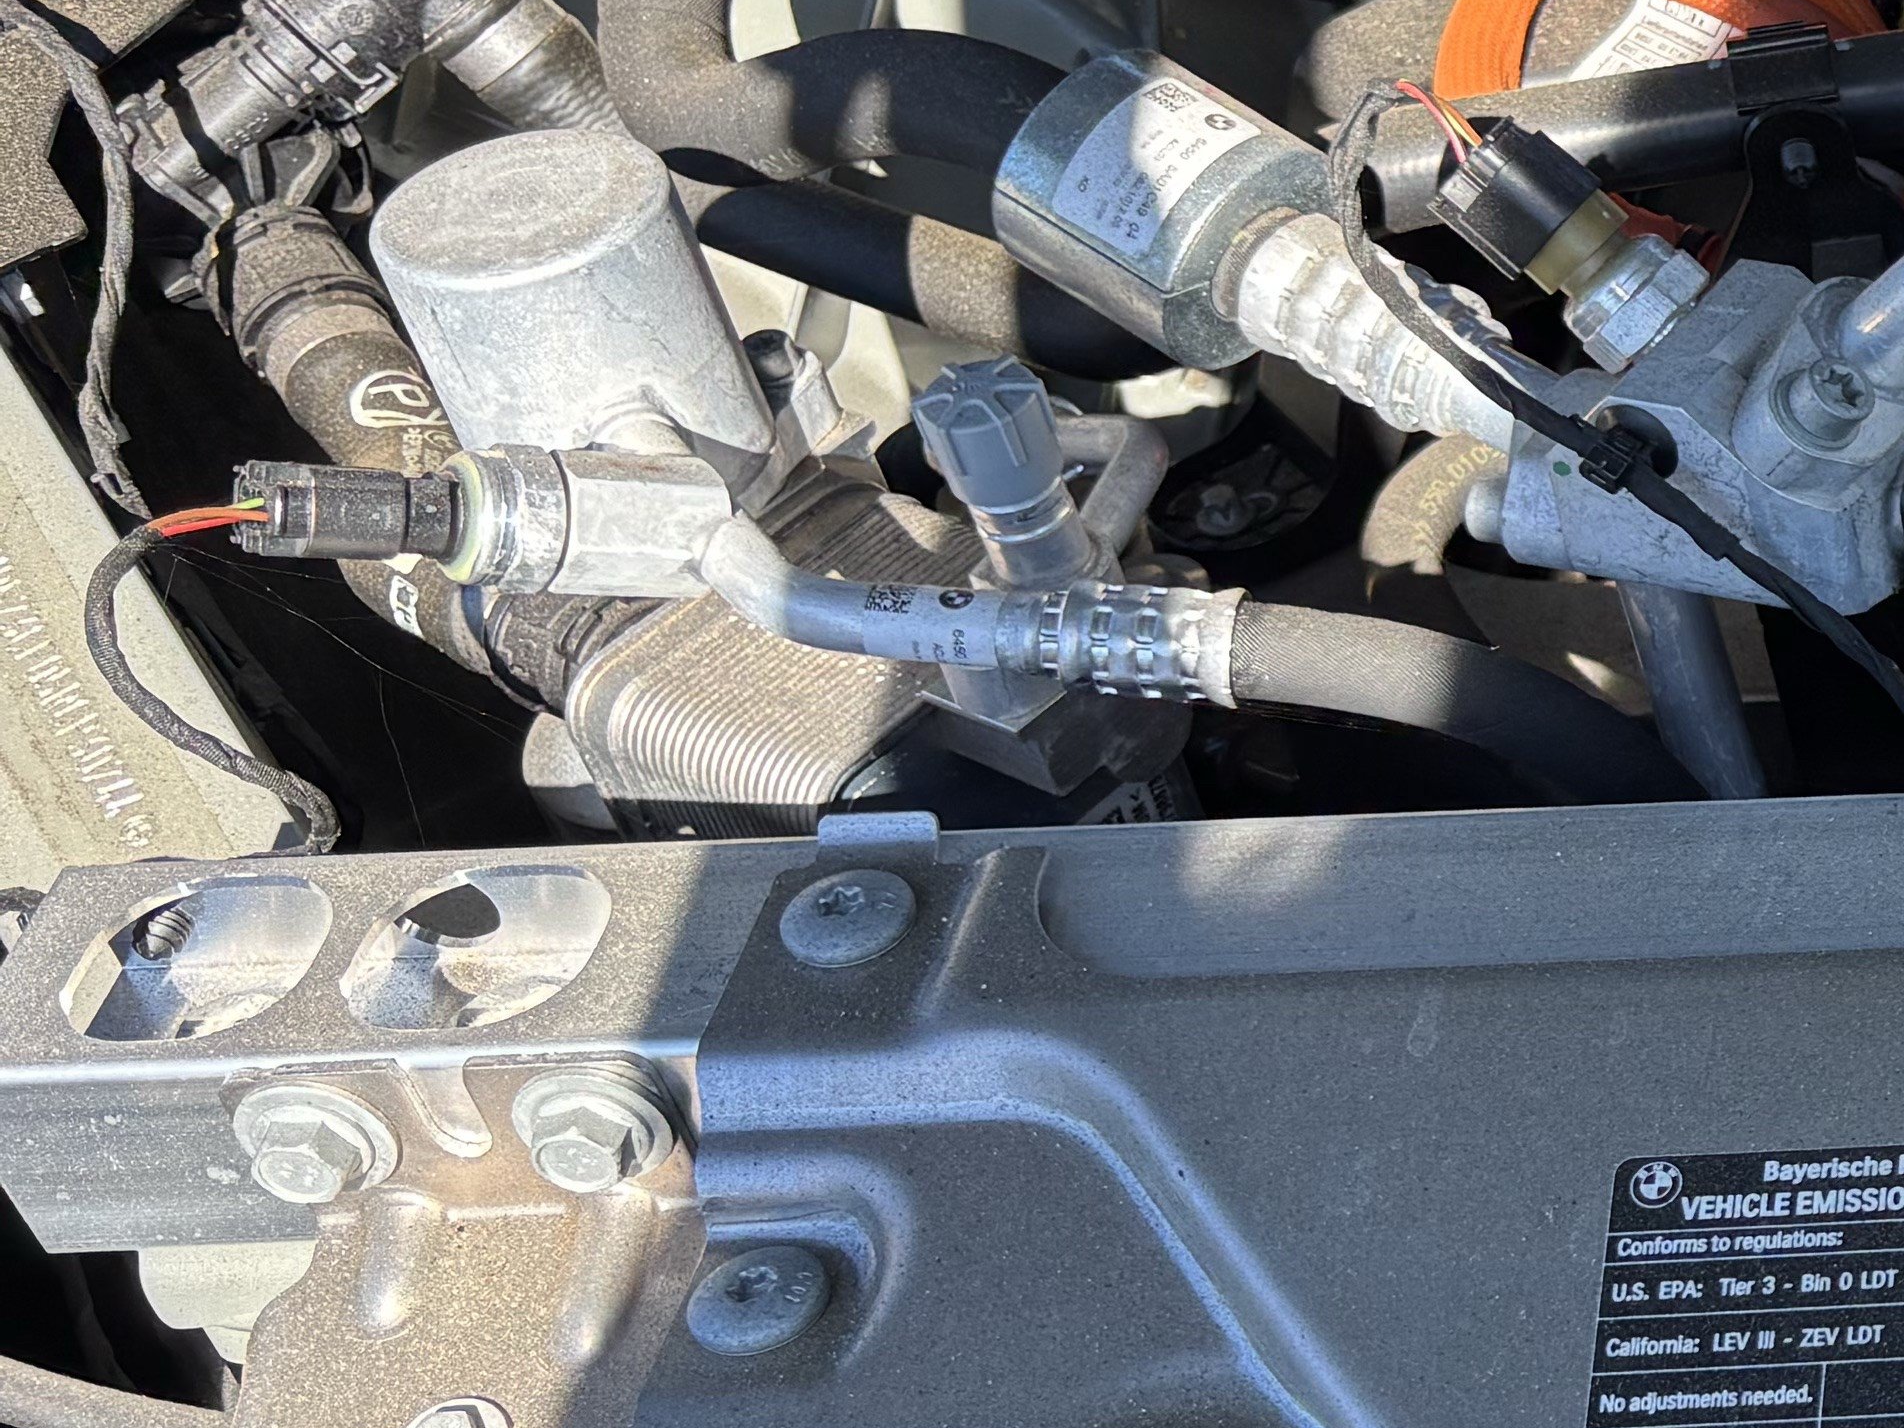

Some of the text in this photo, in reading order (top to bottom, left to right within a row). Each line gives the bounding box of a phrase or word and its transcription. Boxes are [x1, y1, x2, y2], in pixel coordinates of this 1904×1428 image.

[1764, 1156, 1892, 1185] Bayerische
[1681, 1193, 1791, 1221] VEHICLE
[1617, 1229, 1844, 1257] Conforms to regulations:
[1611, 1281, 1650, 1302] U.S.
[1658, 1279, 1703, 1300] EPA:
[1719, 1275, 1756, 1296] Tier
[1761, 1275, 1776, 1294] 3
[1801, 1272, 1832, 1292] Bin
[1839, 1271, 1854, 1291] 0
[1861, 1269, 1899, 1290] LDT
[1605, 1334, 1700, 1357] California:
[1713, 1330, 1751, 1352] LEV
[1800, 1327, 1839, 1349] ZEV
[1848, 1324, 1885, 1346] LDT
[1599, 1382, 1814, 1414] No adjustments needed.
